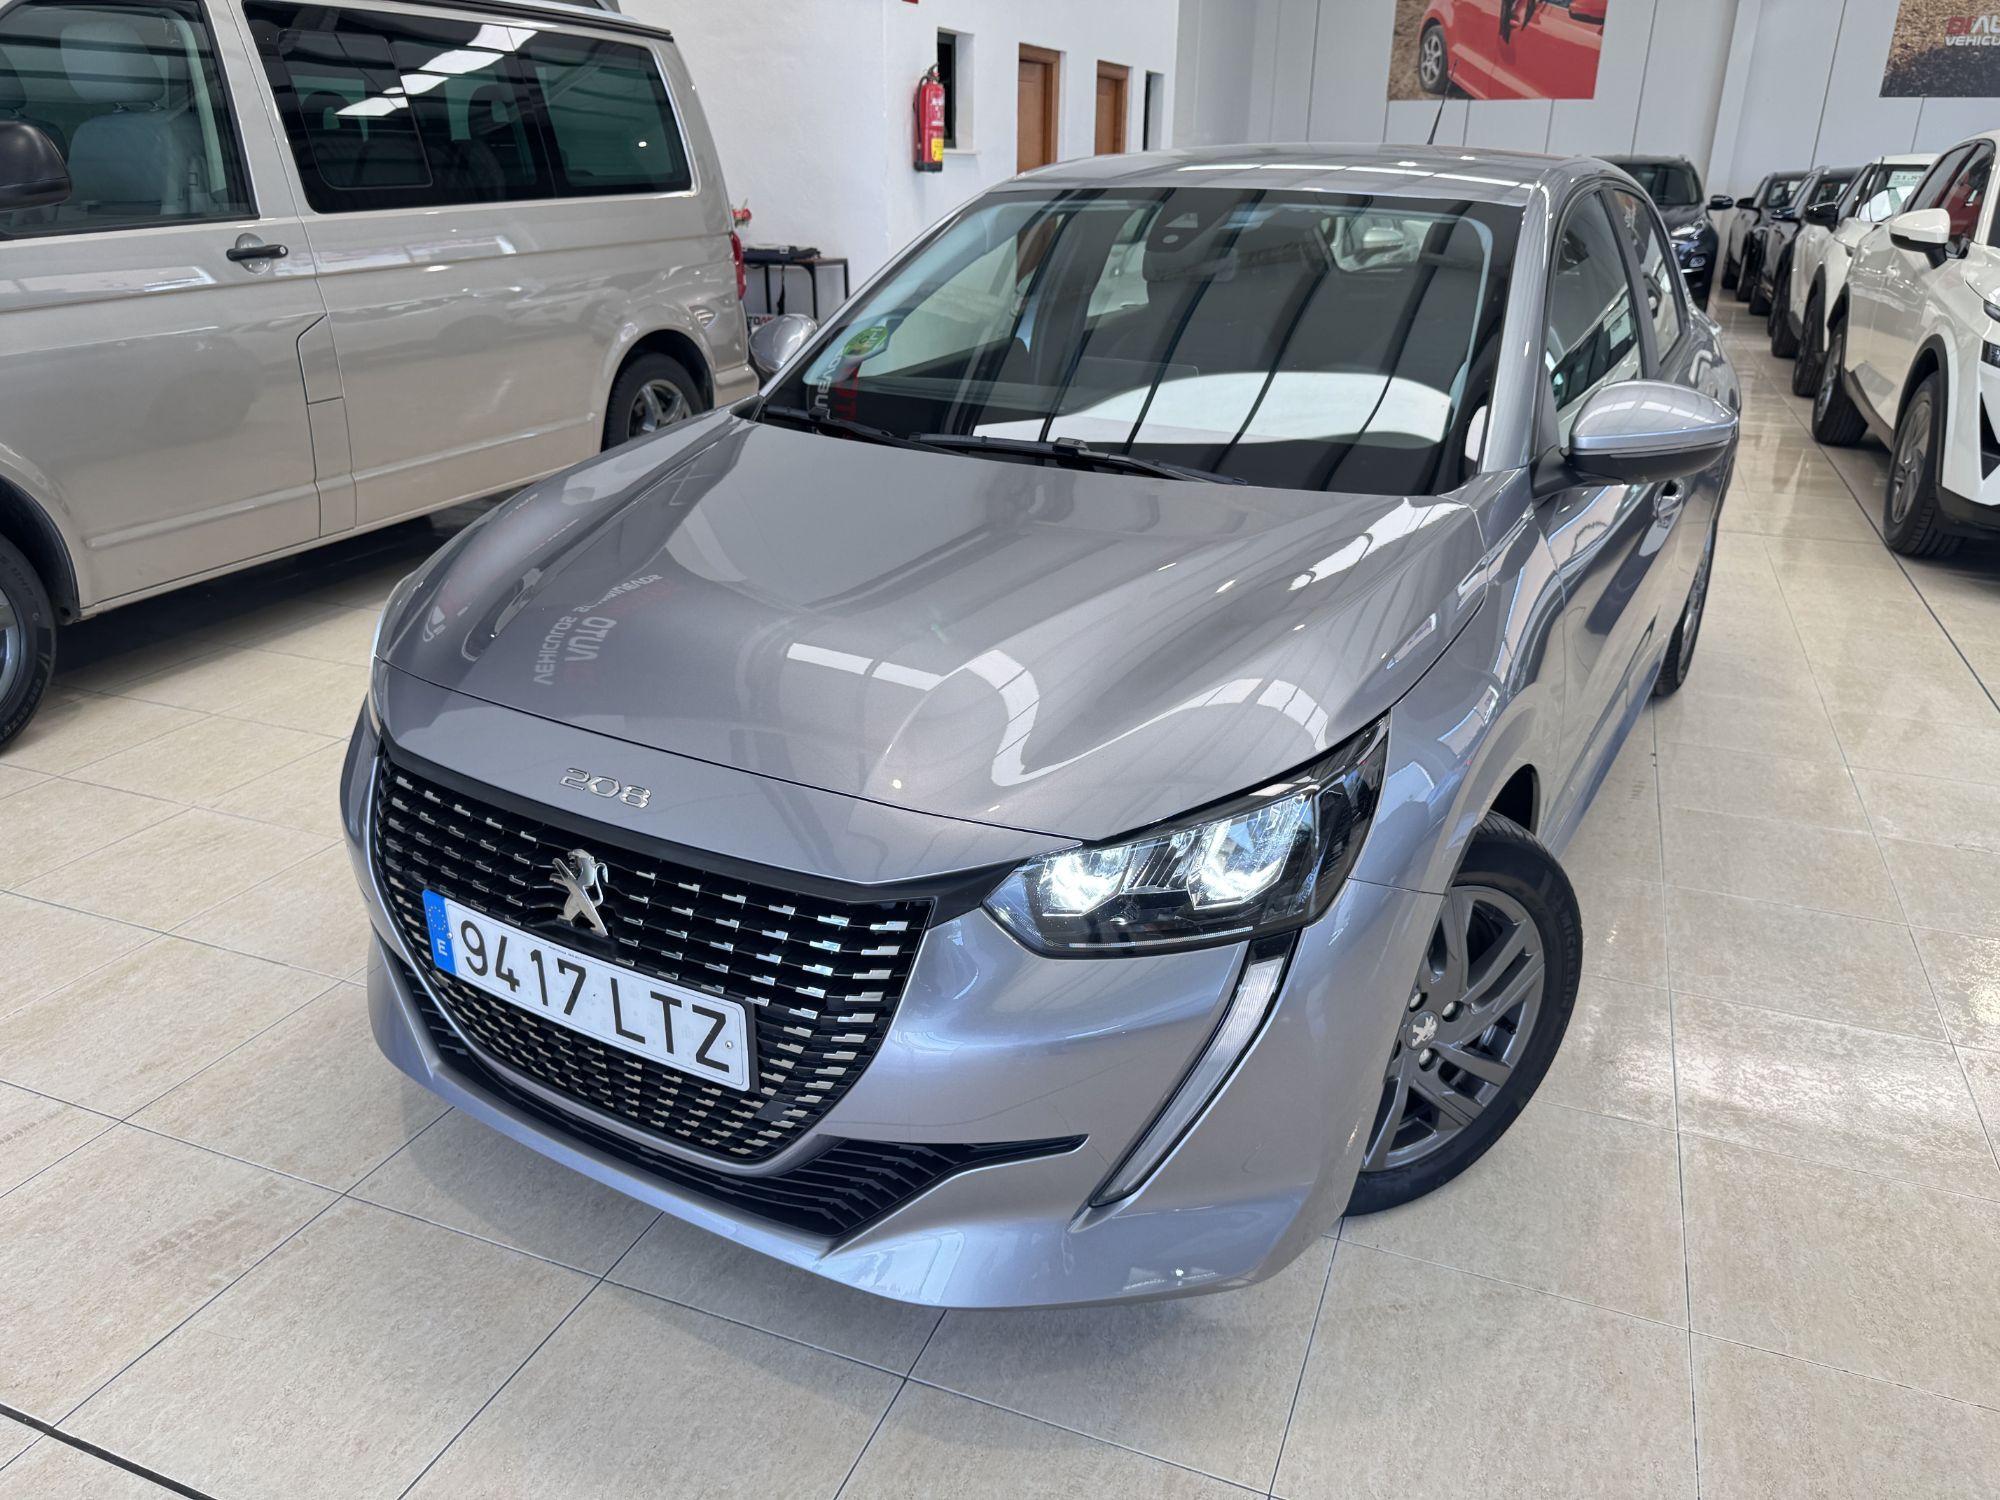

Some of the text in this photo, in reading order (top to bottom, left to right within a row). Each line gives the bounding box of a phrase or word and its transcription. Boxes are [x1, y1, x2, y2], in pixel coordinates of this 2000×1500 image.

[560, 767, 651, 809] 208
[437, 938, 448, 957] E
[460, 920, 730, 1073] 9417 LTZ
